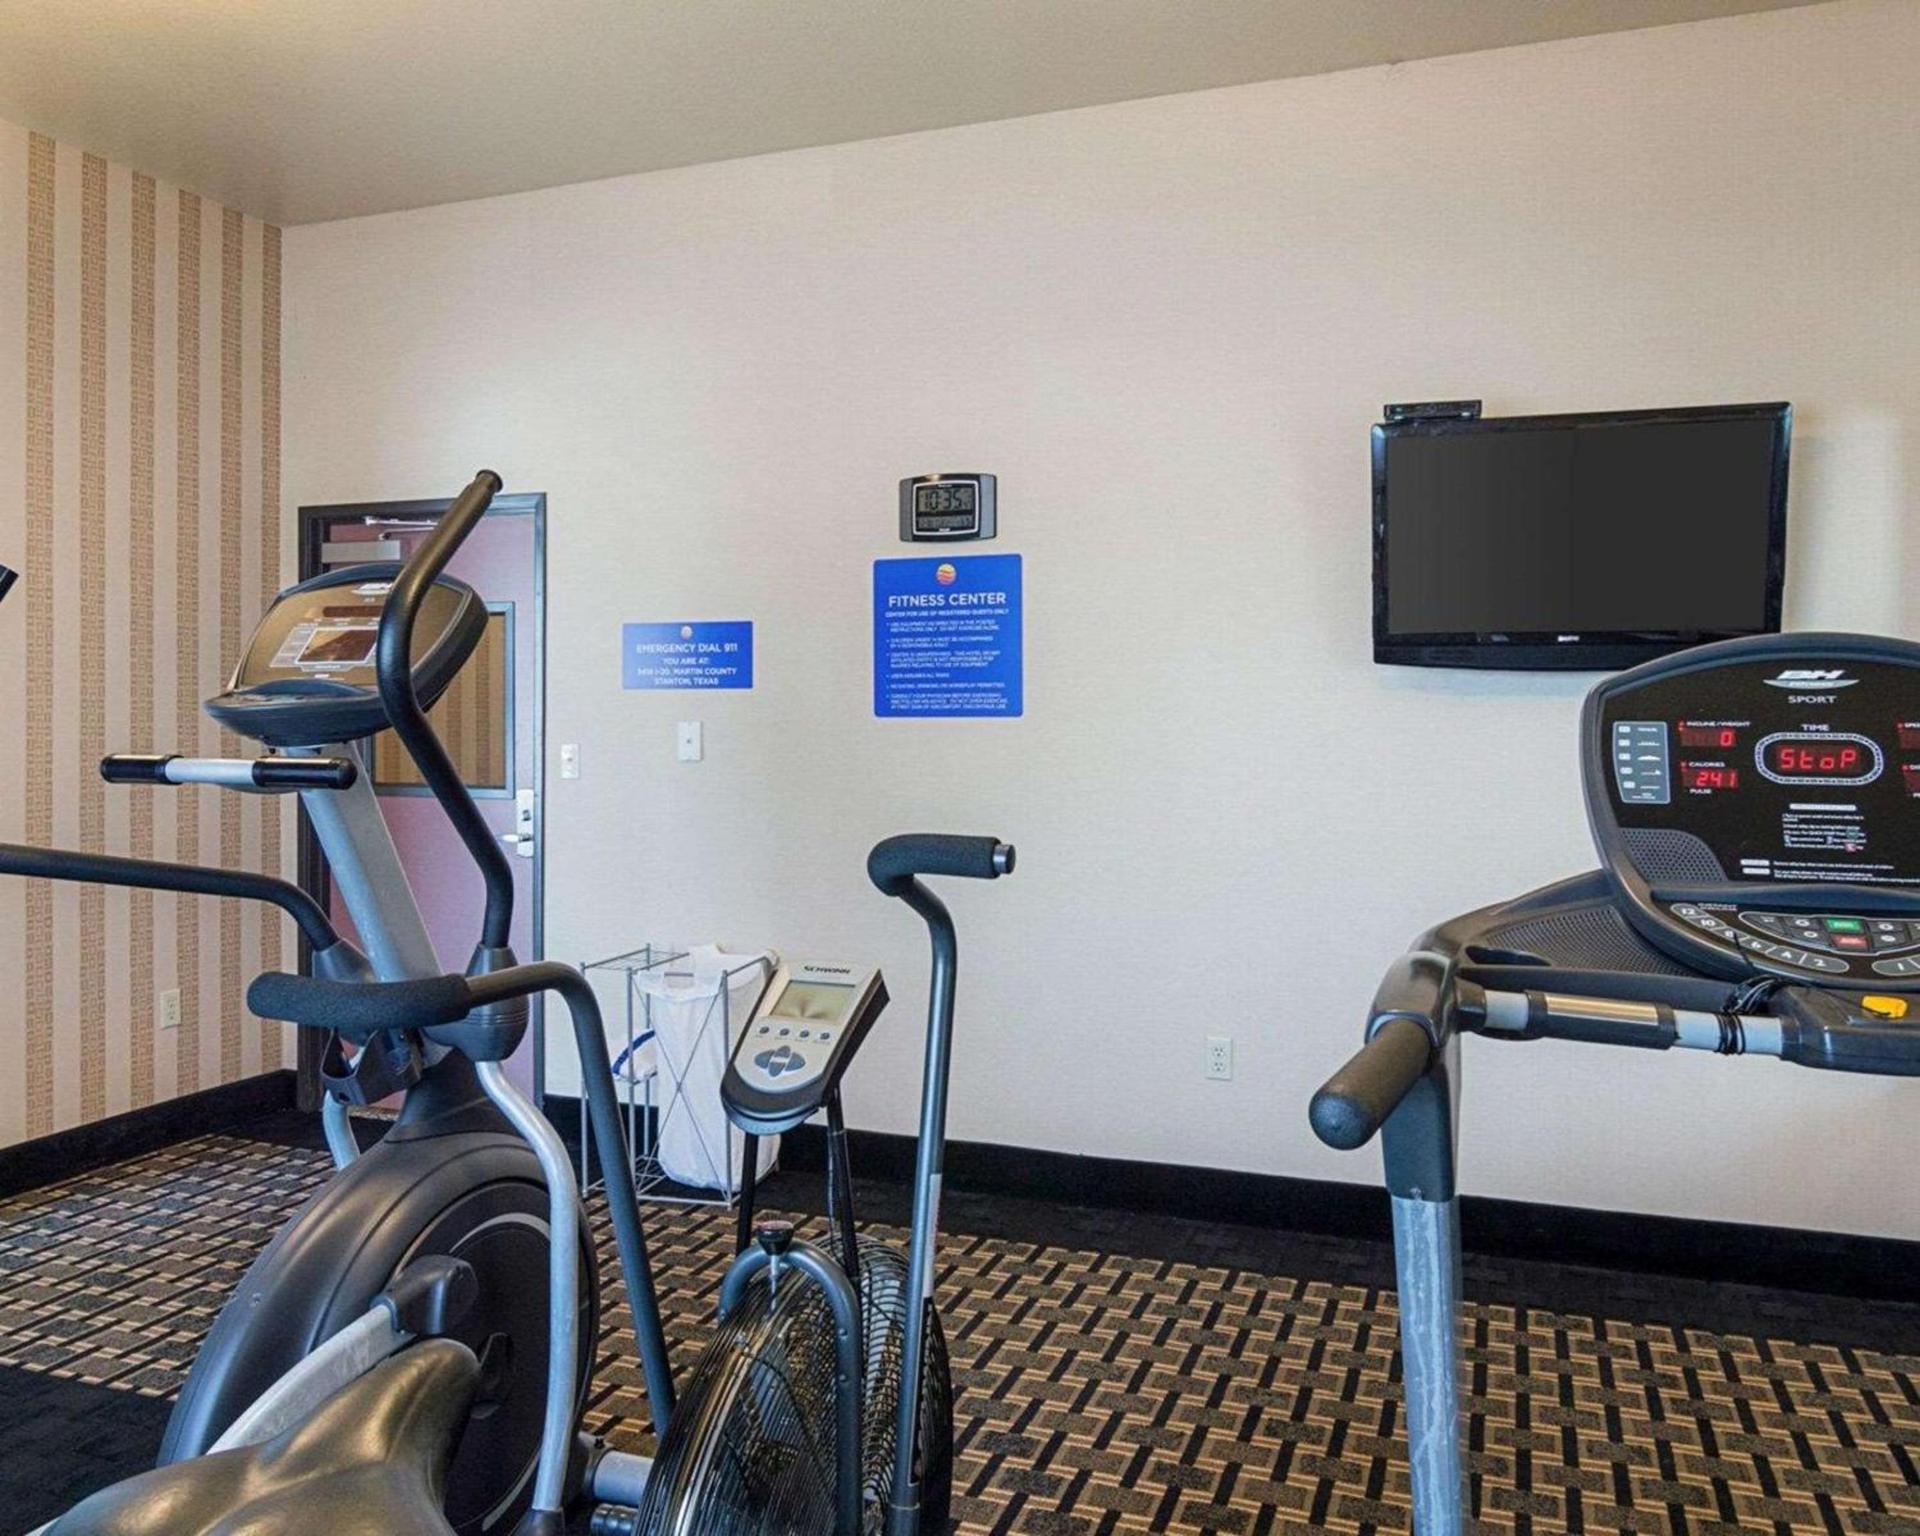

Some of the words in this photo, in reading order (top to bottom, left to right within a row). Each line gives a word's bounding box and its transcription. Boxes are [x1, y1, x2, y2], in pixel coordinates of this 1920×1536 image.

[888, 594, 945, 607] FITNESS
[948, 592, 1007, 605] CENTER
[636, 643, 696, 654] EMERGENCY
[698, 642, 723, 652] DIAL
[724, 642, 738, 652] 911
[680, 657, 697, 665] ARE
[673, 668, 703, 676] MARTIN
[704, 667, 738, 676] COUNTY
[693, 677, 719, 686] TEXAS
[1787, 695, 1837, 704] SPORT
[1801, 723, 1830, 732] TIME
[1720, 730, 1734, 746] 0
[1696, 771, 1738, 787] 241
[1681, 908, 1696, 916] 12
[1701, 919, 1716, 928] 10
[1814, 958, 1827, 967] 2
